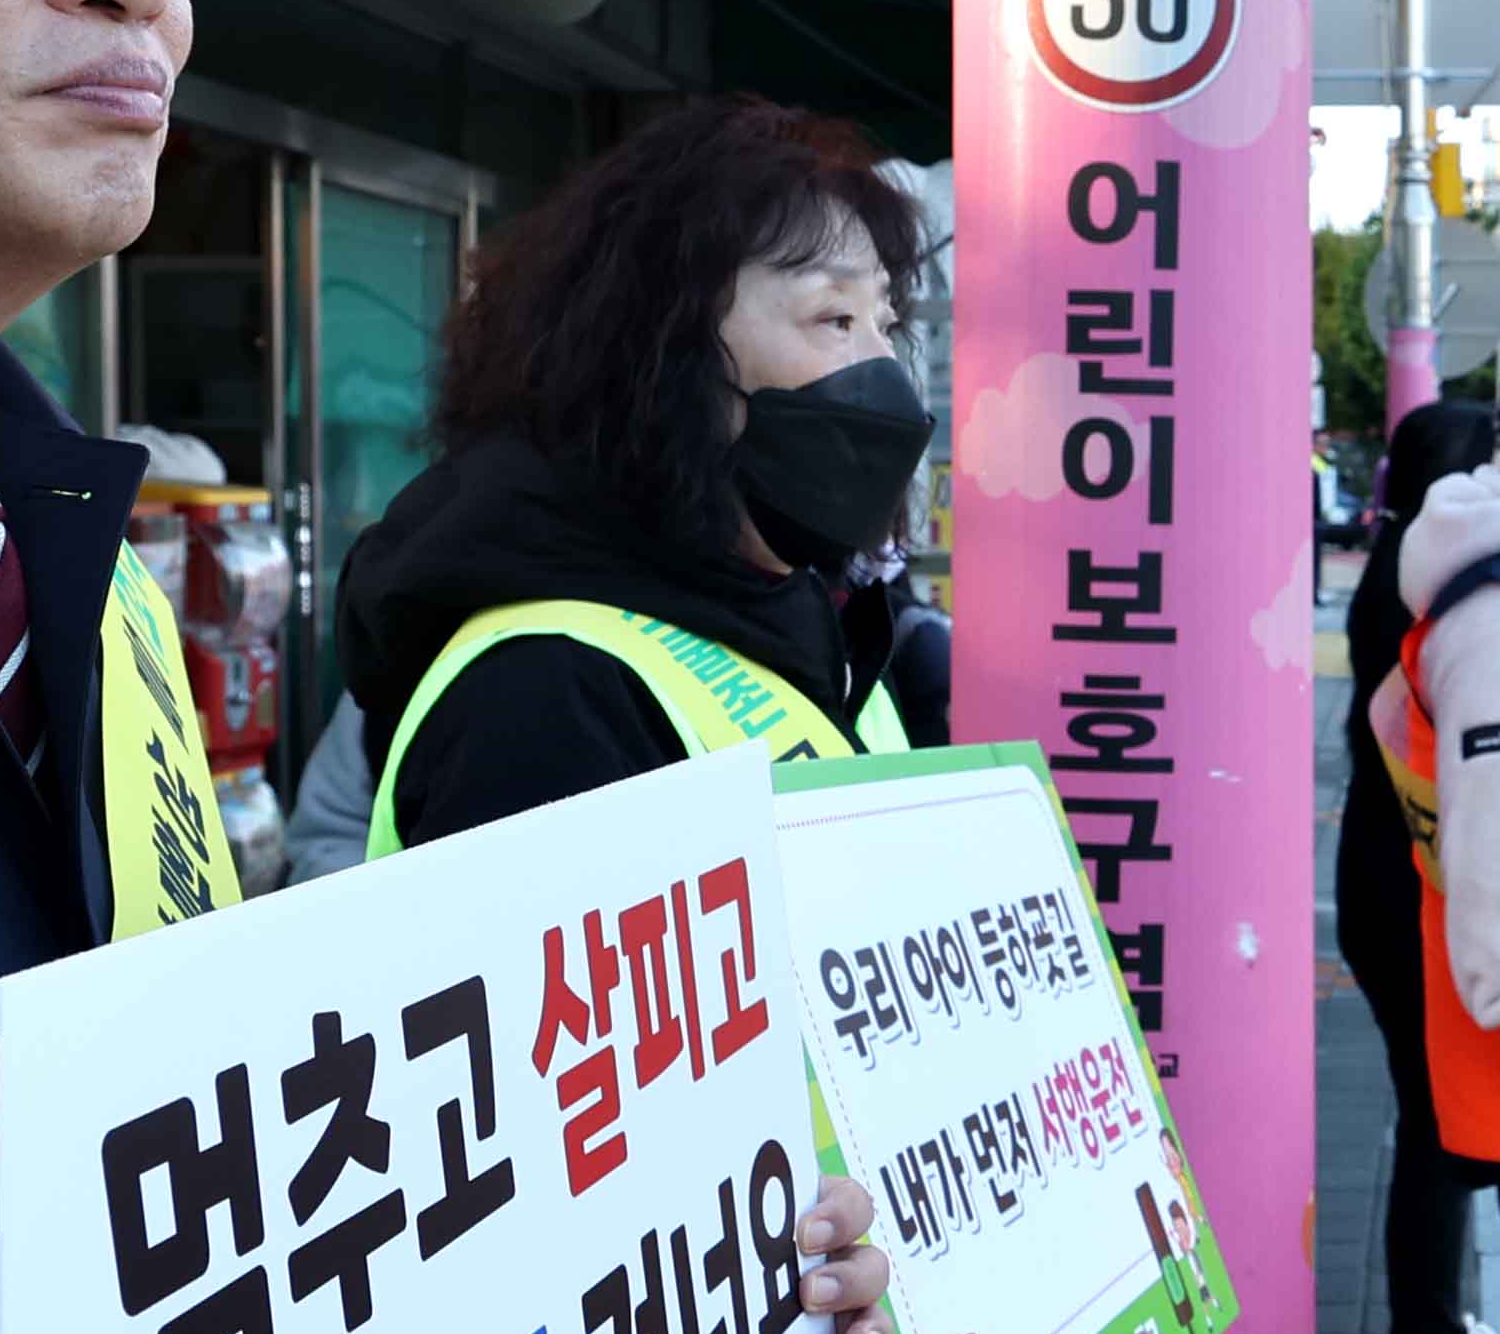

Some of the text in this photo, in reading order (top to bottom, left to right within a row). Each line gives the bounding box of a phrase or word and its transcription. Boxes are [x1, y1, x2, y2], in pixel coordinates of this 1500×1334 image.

[531, 857, 770, 1198] 살피고
[818, 888, 1089, 1057] 우리 아이 등하굣길
[880, 1036, 1142, 1248] 내가 먼저 서행운전
